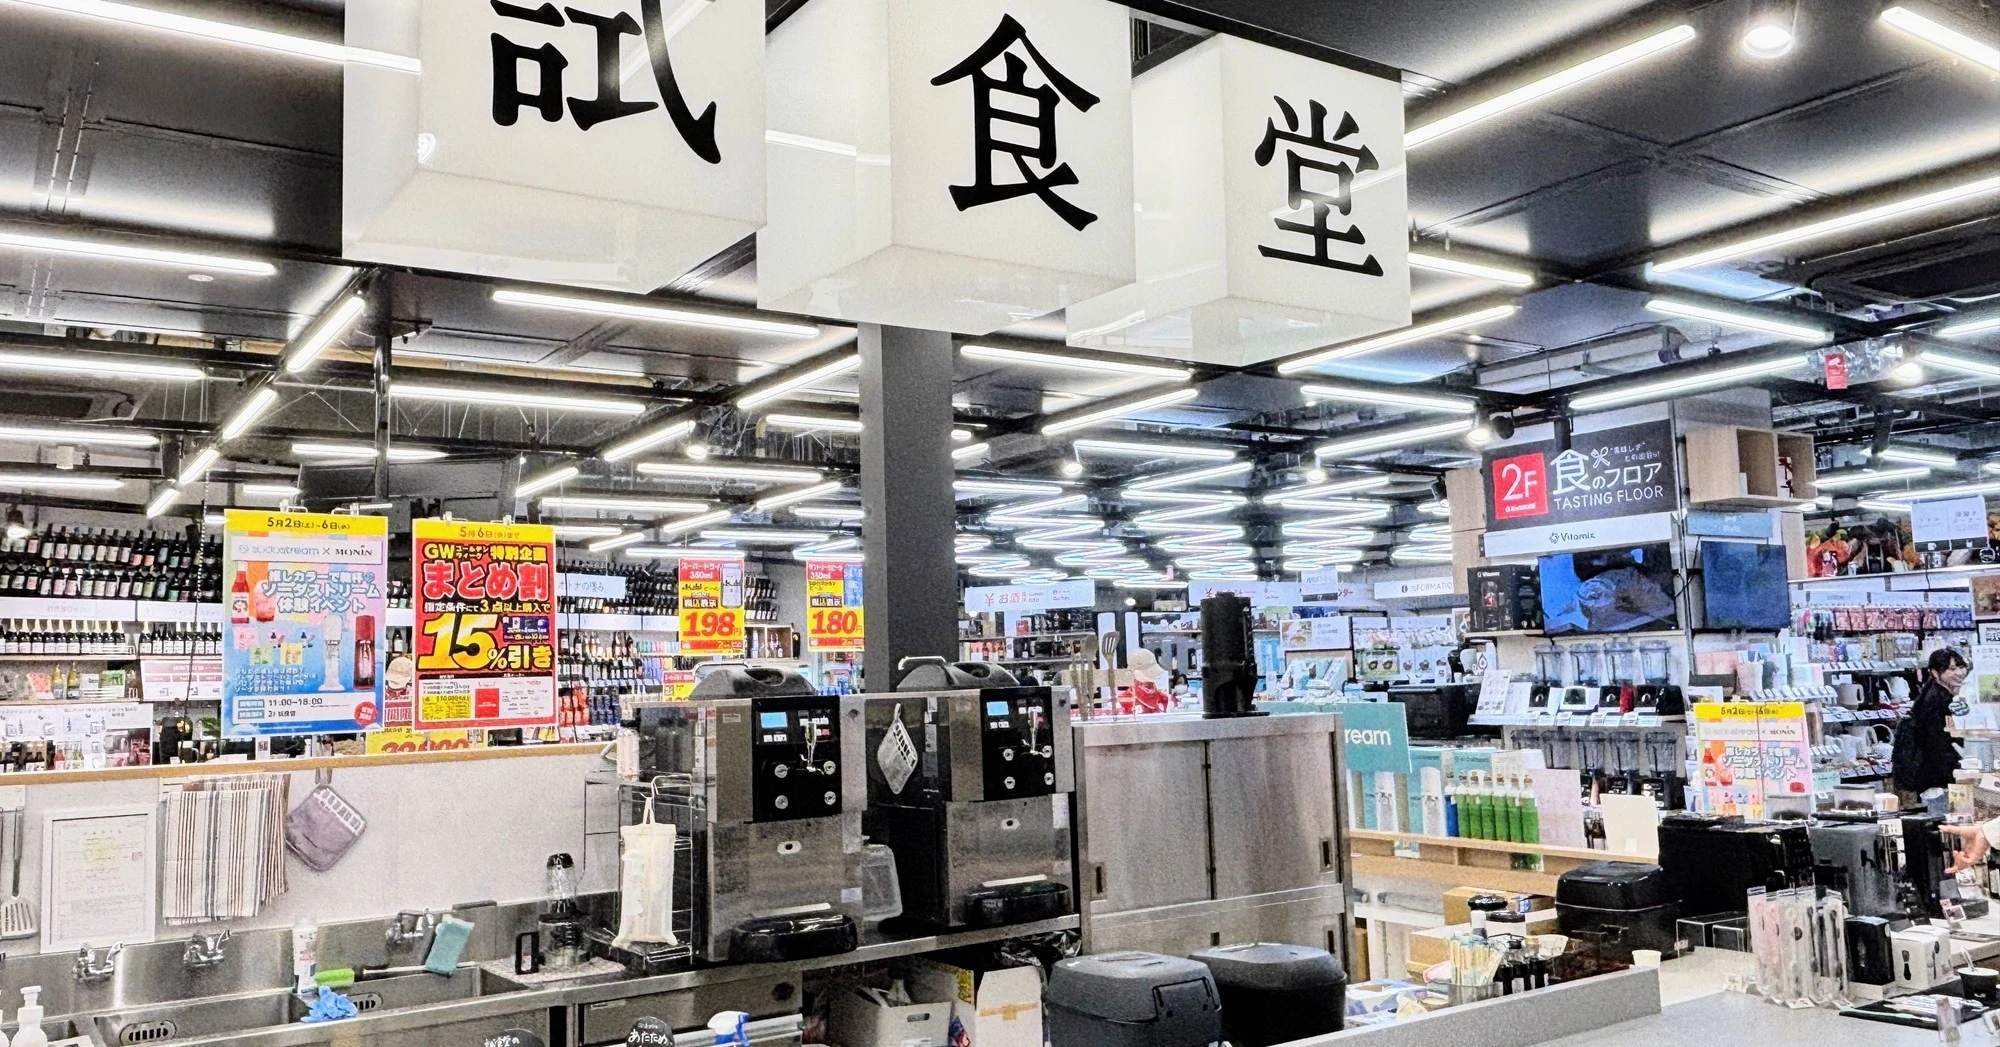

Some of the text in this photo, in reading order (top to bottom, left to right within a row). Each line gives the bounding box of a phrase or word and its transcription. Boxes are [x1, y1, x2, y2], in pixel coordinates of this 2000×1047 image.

[1501, 463, 1537, 501] 2F
[1550, 449, 1662, 495] 食のフロア
[1554, 493, 1613, 510] TASTING
[1617, 485, 1664, 503] FLOOR
[335, 545, 373, 556] MONIN
[424, 543, 454, 559] GW
[262, 583, 381, 599] ソーダストリーム
[423, 560, 549, 601] まとめ割
[418, 613, 553, 670] 15%引き
